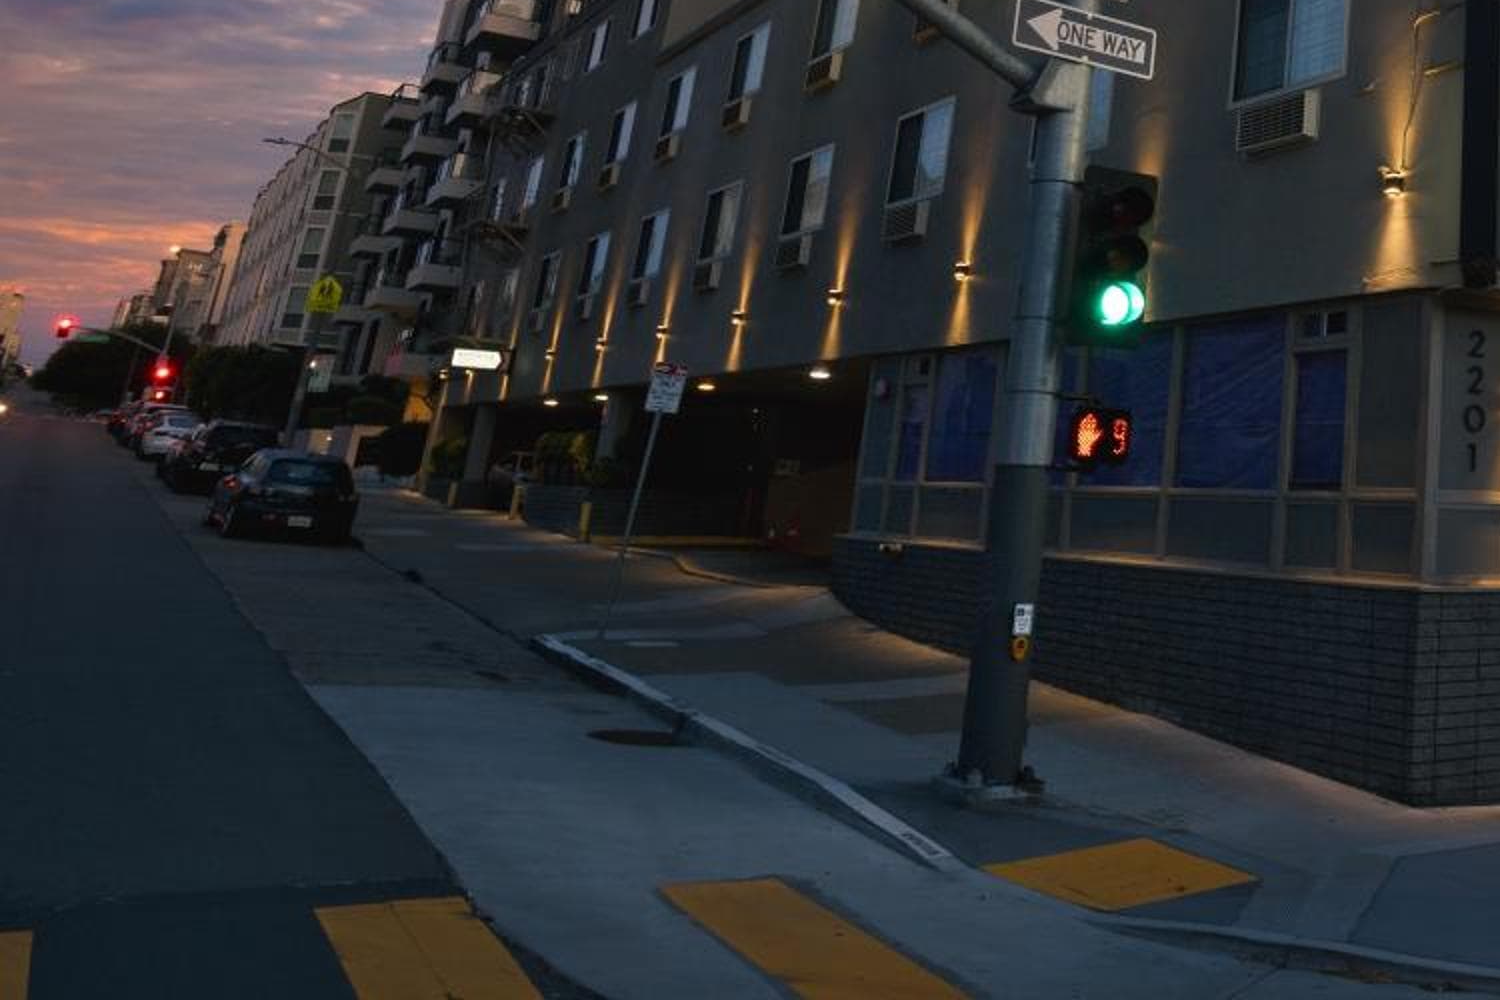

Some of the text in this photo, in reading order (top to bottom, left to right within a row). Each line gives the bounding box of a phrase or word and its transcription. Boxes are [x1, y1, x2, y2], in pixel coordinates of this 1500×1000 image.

[1057, 21, 1144, 60] ONE WAY
[1463, 330, 1486, 472] 2201
[1113, 419, 1128, 455] 9
